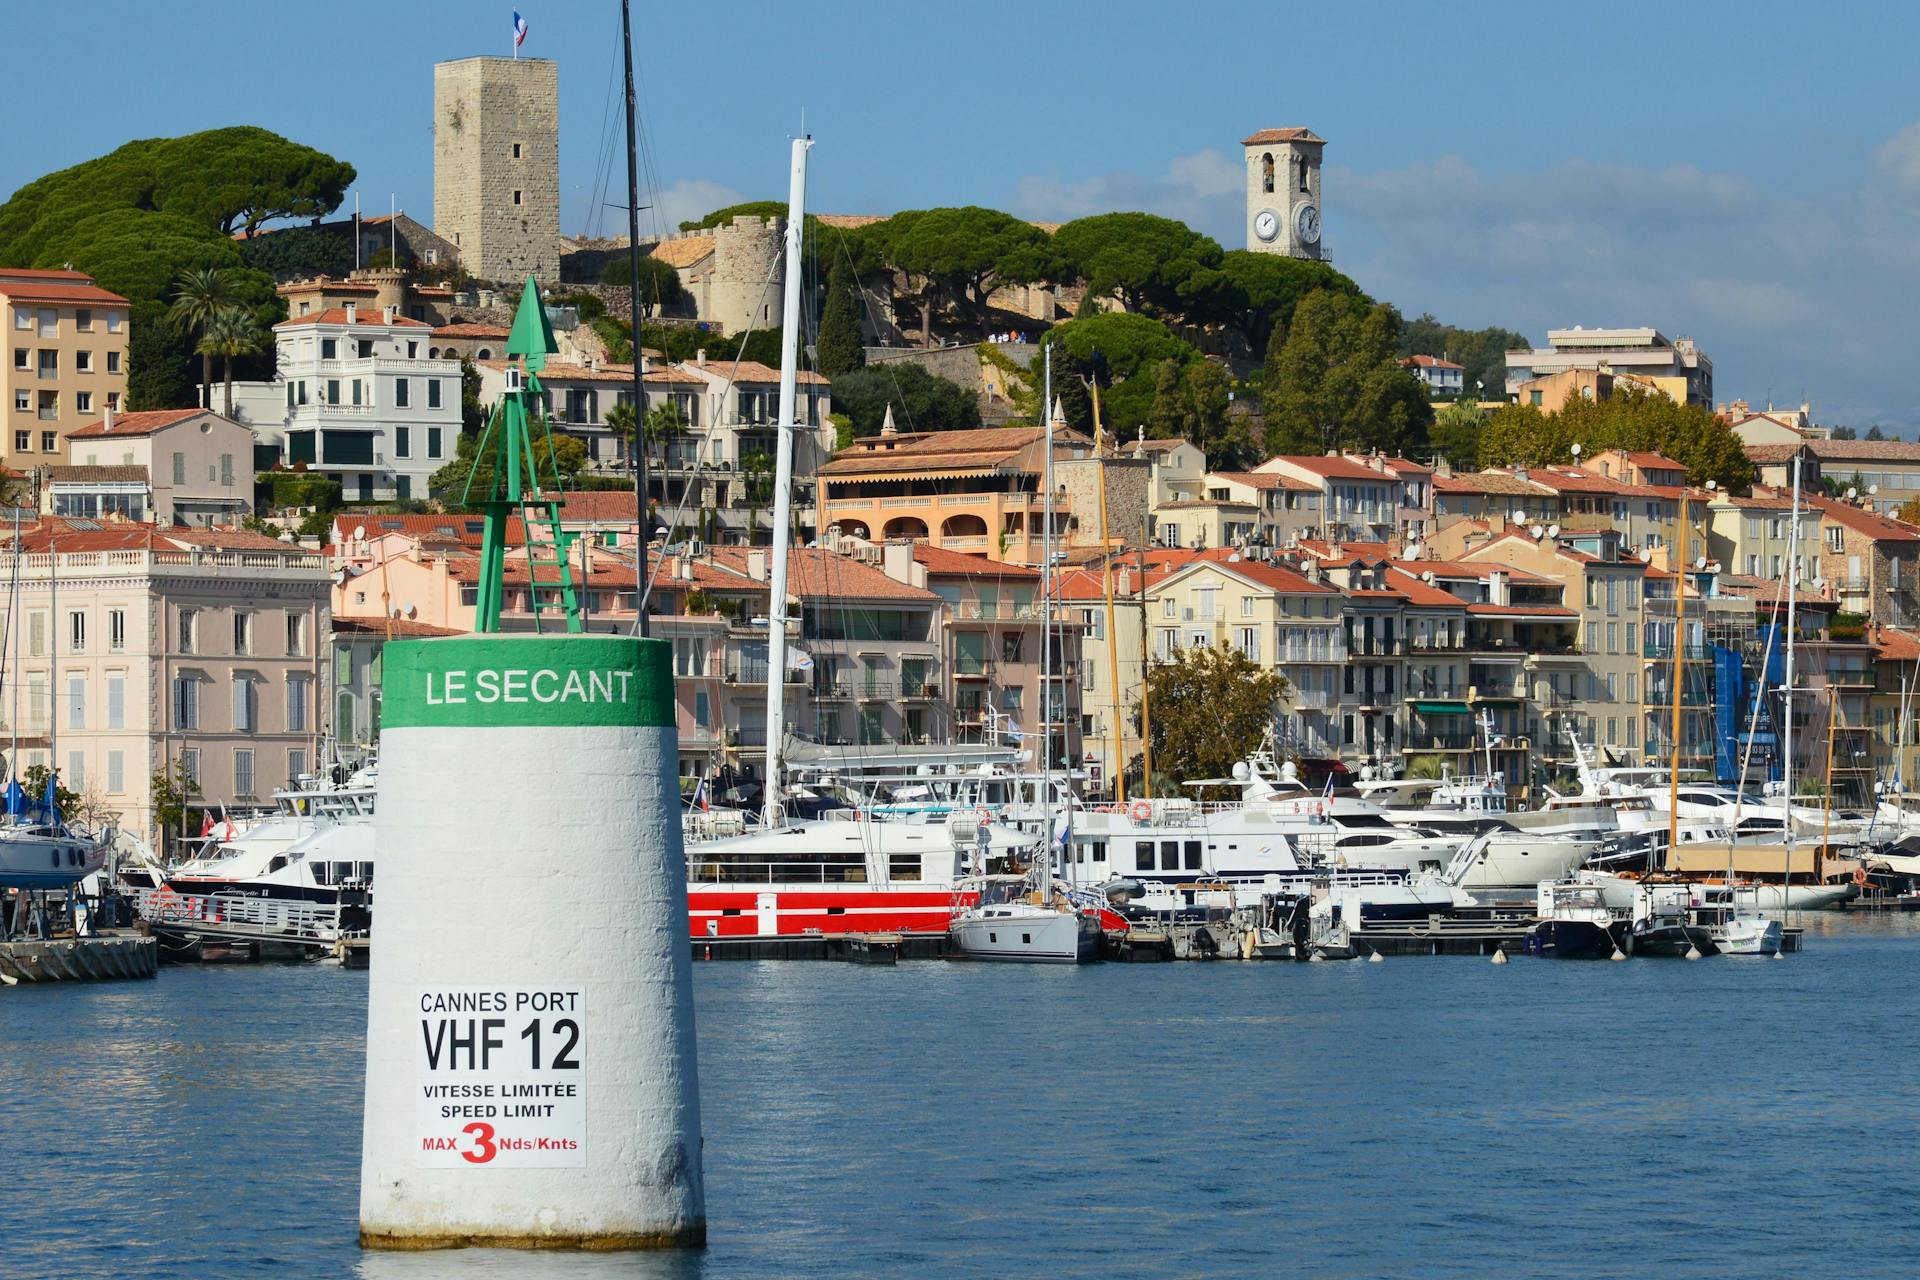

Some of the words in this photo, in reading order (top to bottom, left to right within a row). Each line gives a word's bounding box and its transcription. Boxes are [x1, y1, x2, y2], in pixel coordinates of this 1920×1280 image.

[426, 670, 467, 705] LE
[475, 669, 634, 704] SECANT
[421, 991, 508, 1013] CANNES
[516, 991, 579, 1012] PORT
[421, 1018, 506, 1071] VHF
[521, 1018, 580, 1070] 12
[423, 1084, 495, 1098] VITESSE
[501, 1081, 577, 1098] LIMITÉE
[441, 1105, 497, 1118] SPEED
[503, 1104, 555, 1118] LIMIT
[422, 1137, 457, 1151] MAX
[460, 1121, 498, 1164] 3
[499, 1136, 578, 1151] Nds/Knts
